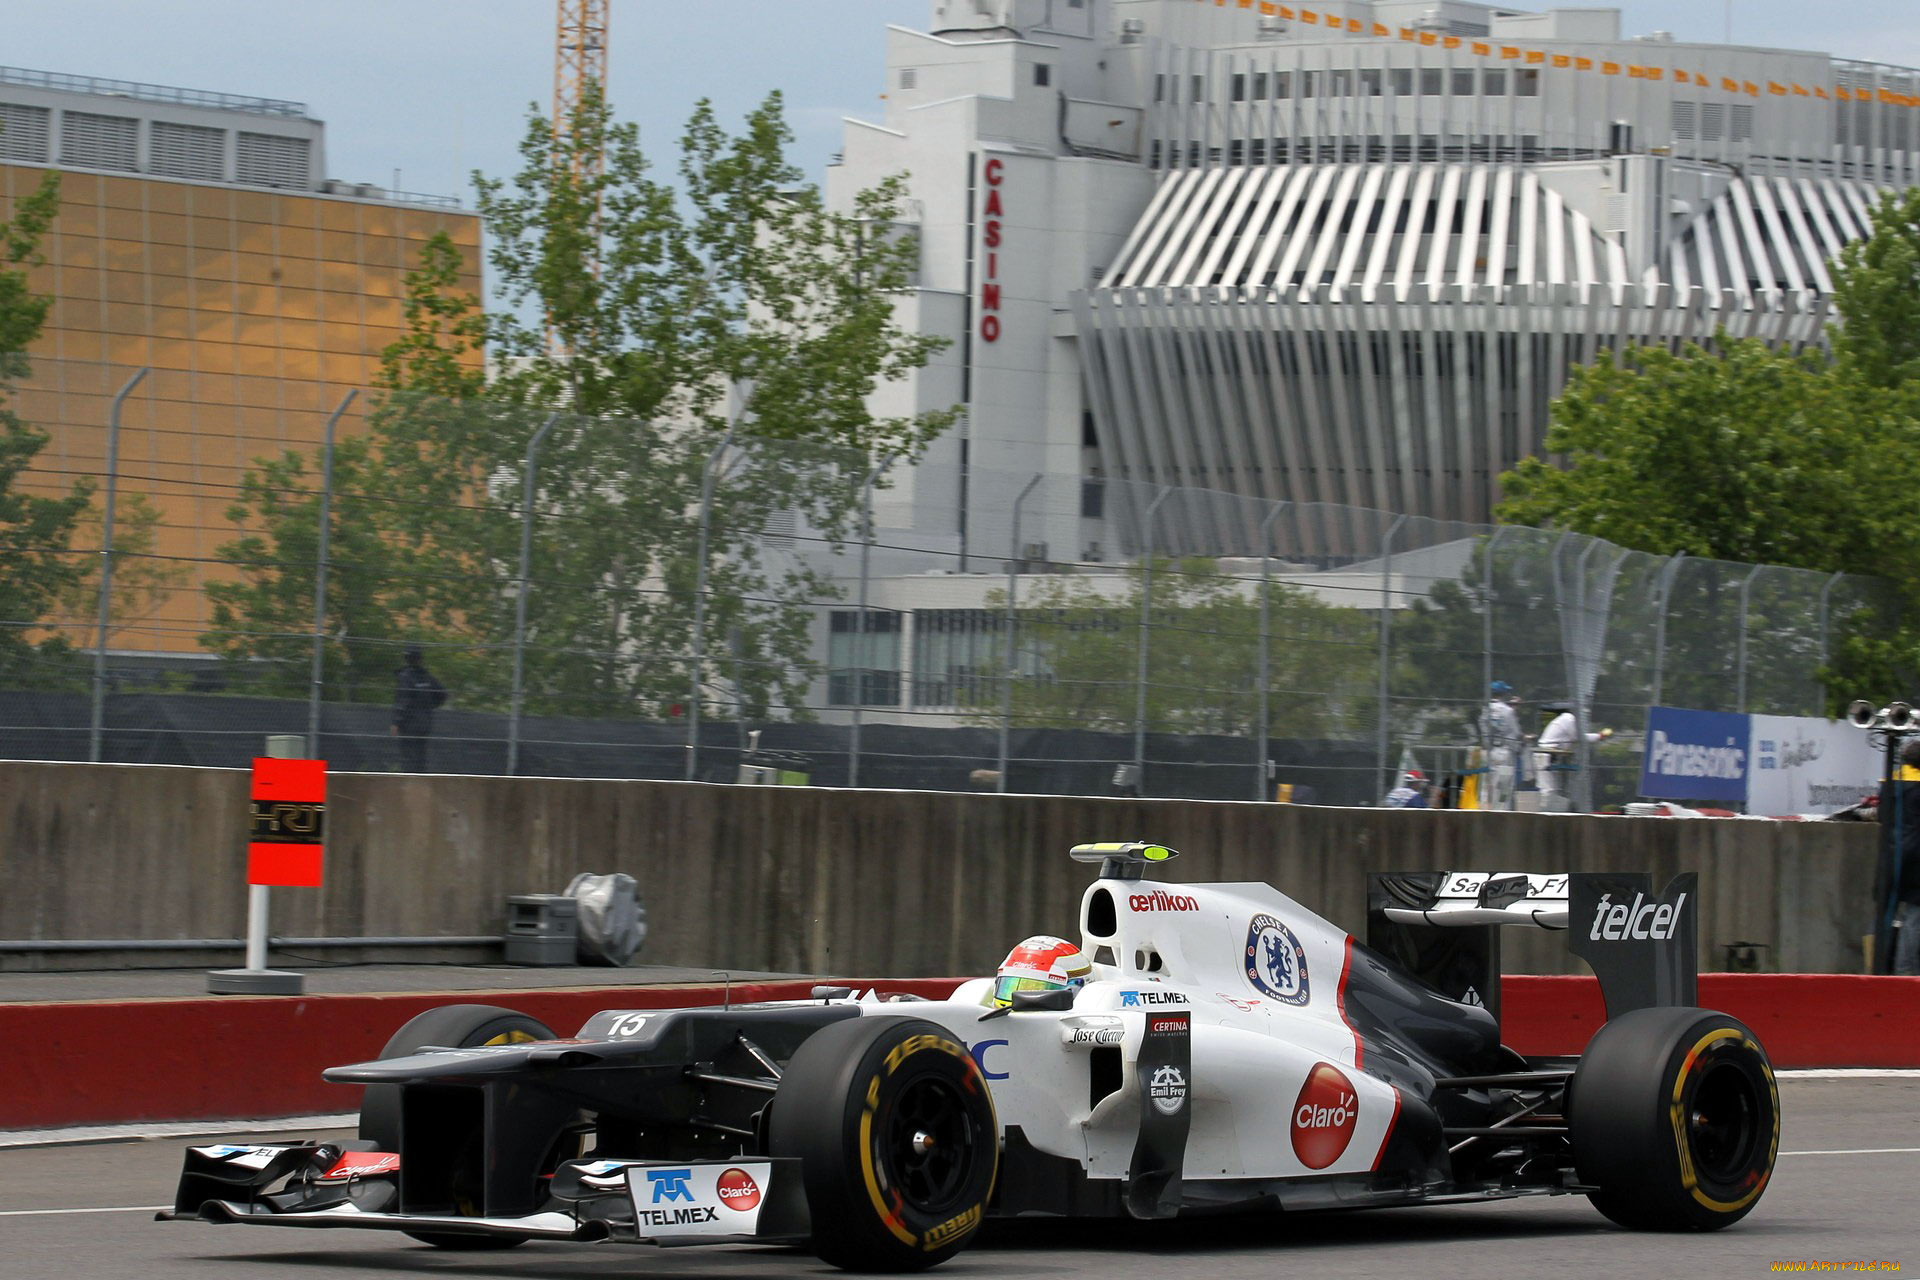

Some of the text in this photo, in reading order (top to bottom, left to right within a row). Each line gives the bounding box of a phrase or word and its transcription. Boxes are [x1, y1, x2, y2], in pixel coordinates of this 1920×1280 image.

[980, 158, 1004, 342] CASINO
[1648, 730, 1745, 780] Panasonic
[1252, 916, 1289, 937] CHELSEA
[1589, 892, 1688, 941] telcel
[1140, 992, 1191, 1005] TELMEX
[607, 1013, 656, 1036] 15
[1154, 1021, 1188, 1032] CERTINA
[1068, 1028, 1095, 1044] Jose
[1150, 1086, 1186, 1098] Emil Frey
[1296, 1097, 1351, 1129] Claro
[719, 1183, 756, 1199] Claro
[640, 1206, 720, 1226] TELMEX
